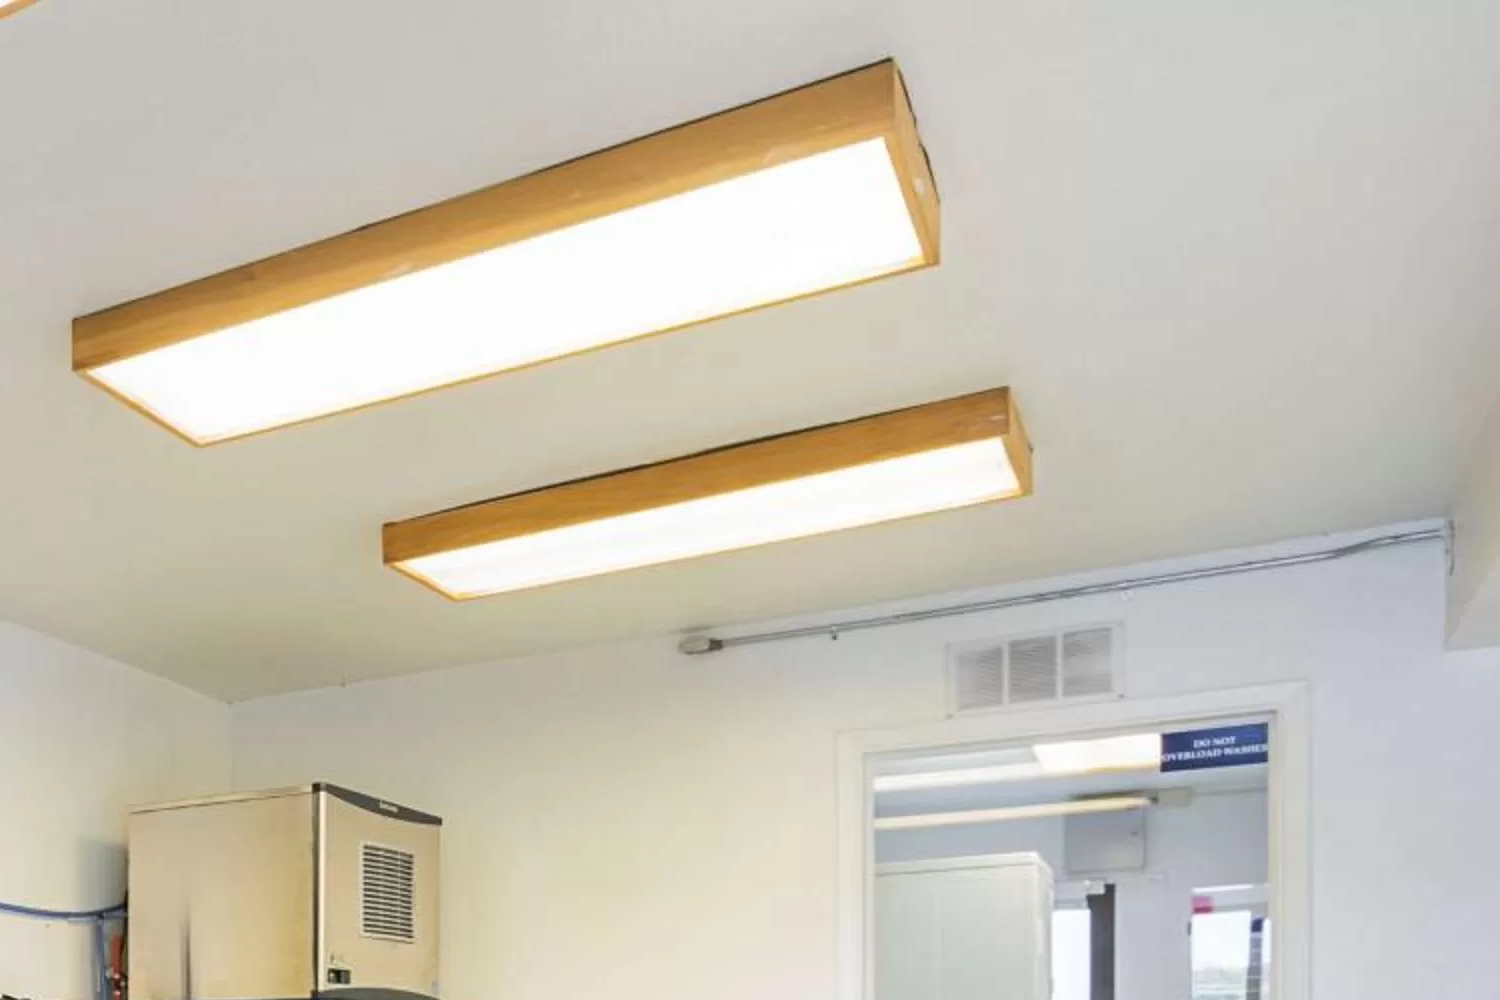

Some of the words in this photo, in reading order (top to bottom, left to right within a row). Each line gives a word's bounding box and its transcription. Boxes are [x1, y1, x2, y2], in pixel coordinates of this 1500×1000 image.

[1192, 738, 1212, 749] DO
[1211, 735, 1237, 746] NOT
[1162, 747, 1222, 762] OVERLOAD
